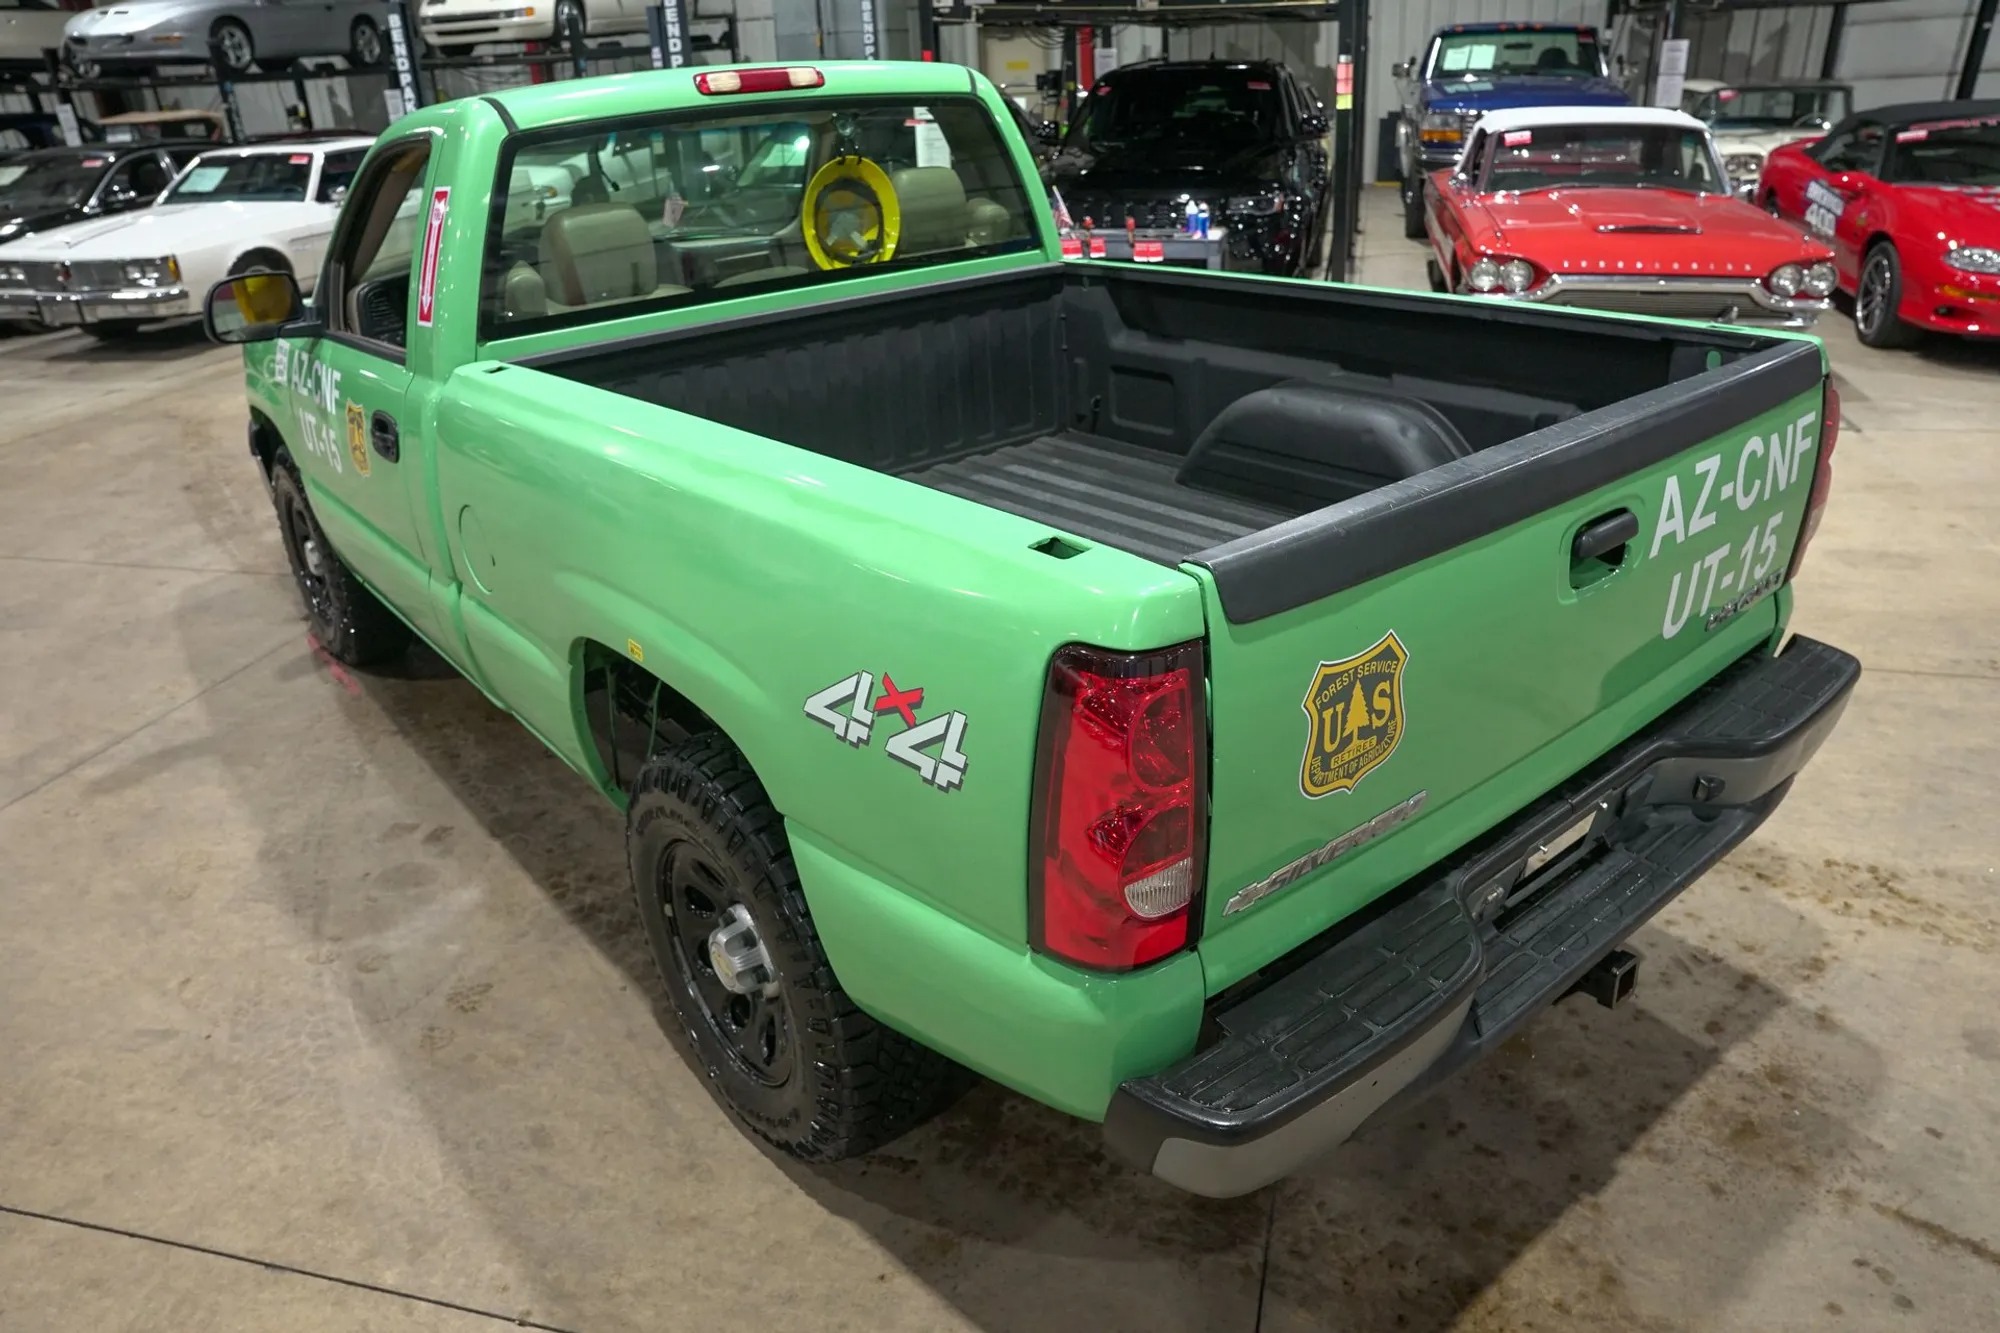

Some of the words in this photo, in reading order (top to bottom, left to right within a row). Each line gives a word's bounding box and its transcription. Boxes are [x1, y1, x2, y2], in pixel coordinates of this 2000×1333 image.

[291, 349, 342, 415] AZ-CNF
[300, 408, 343, 474] UT-15
[1648, 410, 1816, 560] AZ-CNF
[1662, 511, 1784, 640] UT-15
[1315, 669, 1355, 709] FOREST
[1357, 660, 1398, 679] SERVICE
[1322, 702, 1345, 753] U
[1371, 680, 1391, 730] S
[1311, 756, 1349, 785] DEPARTMENT
[1348, 759, 1359, 775] OF
[1359, 717, 1397, 769] AGRICULTURE
[1332, 738, 1376, 767] RETIREE
